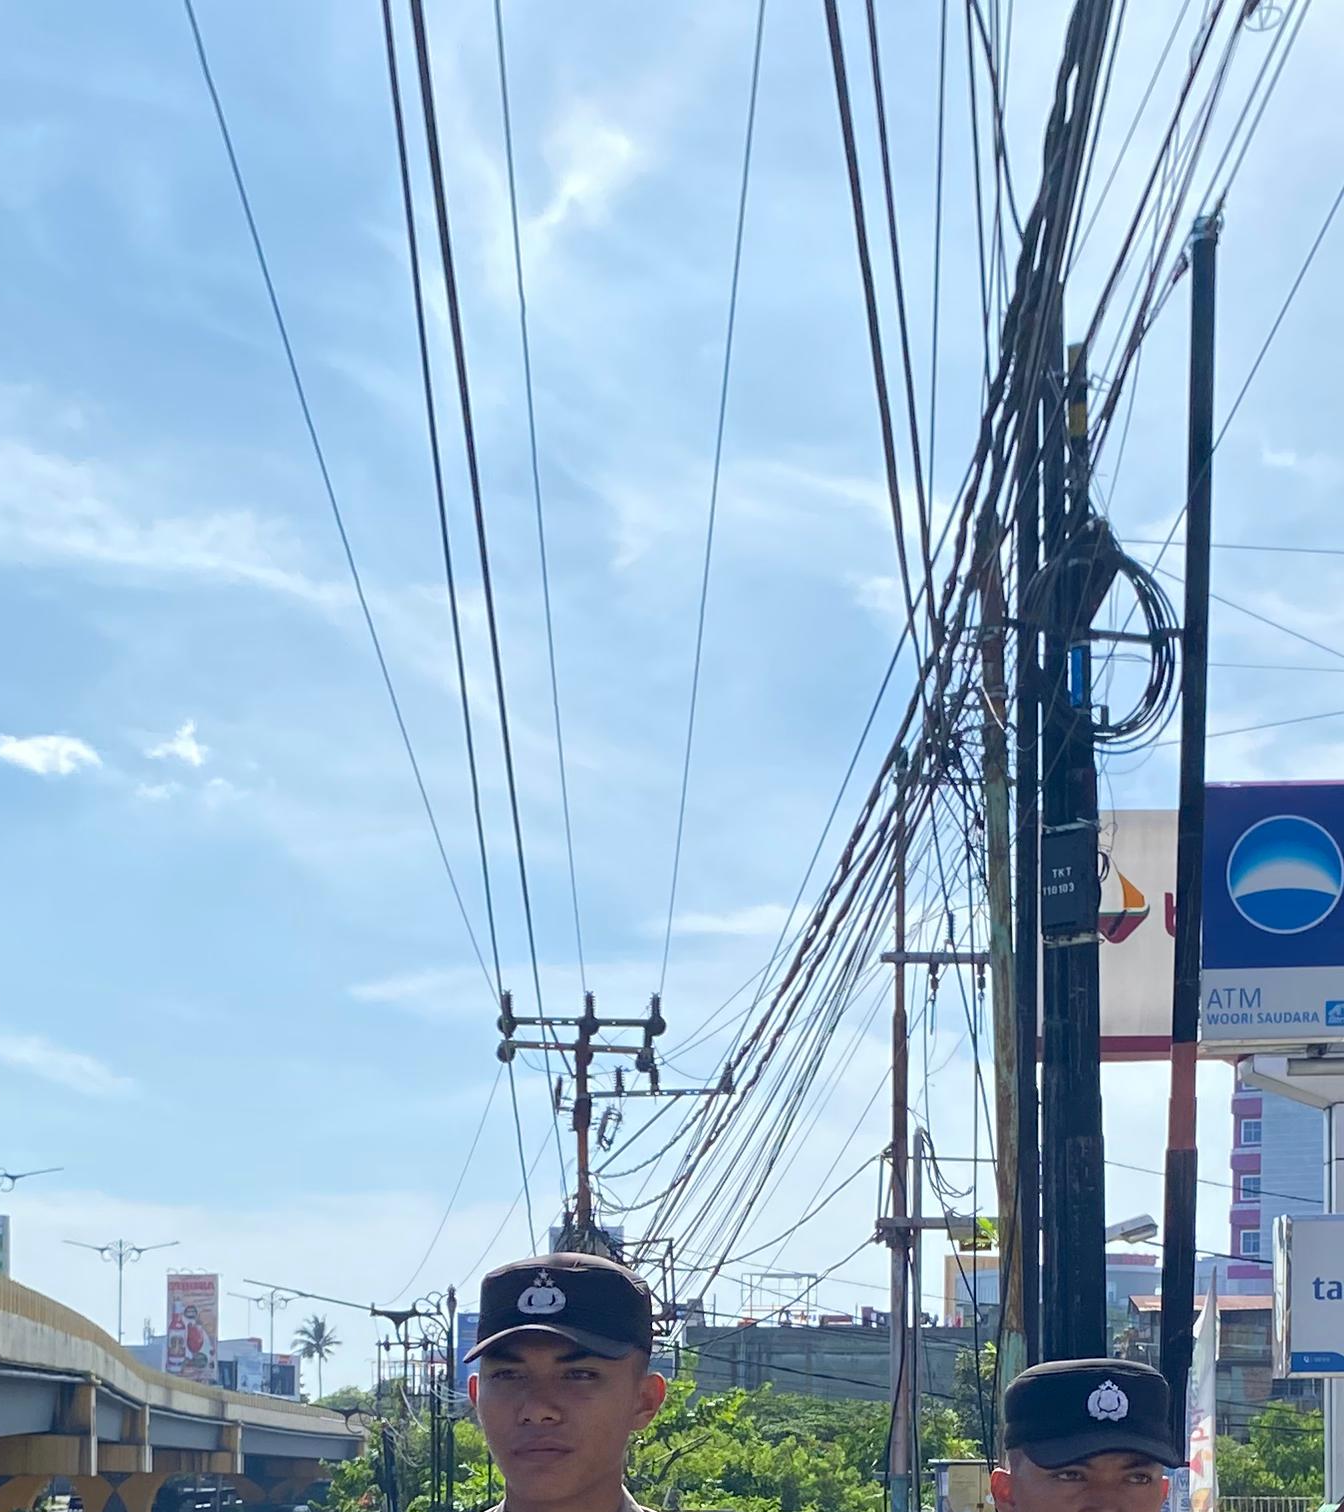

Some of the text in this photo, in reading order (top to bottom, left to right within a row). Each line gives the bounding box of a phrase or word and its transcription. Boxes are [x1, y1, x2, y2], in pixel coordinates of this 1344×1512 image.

[1052, 867, 1072, 878] TKT
[1207, 987, 1262, 1009] ATM
[1207, 1011, 1320, 1025] WOORI SAUDARA
